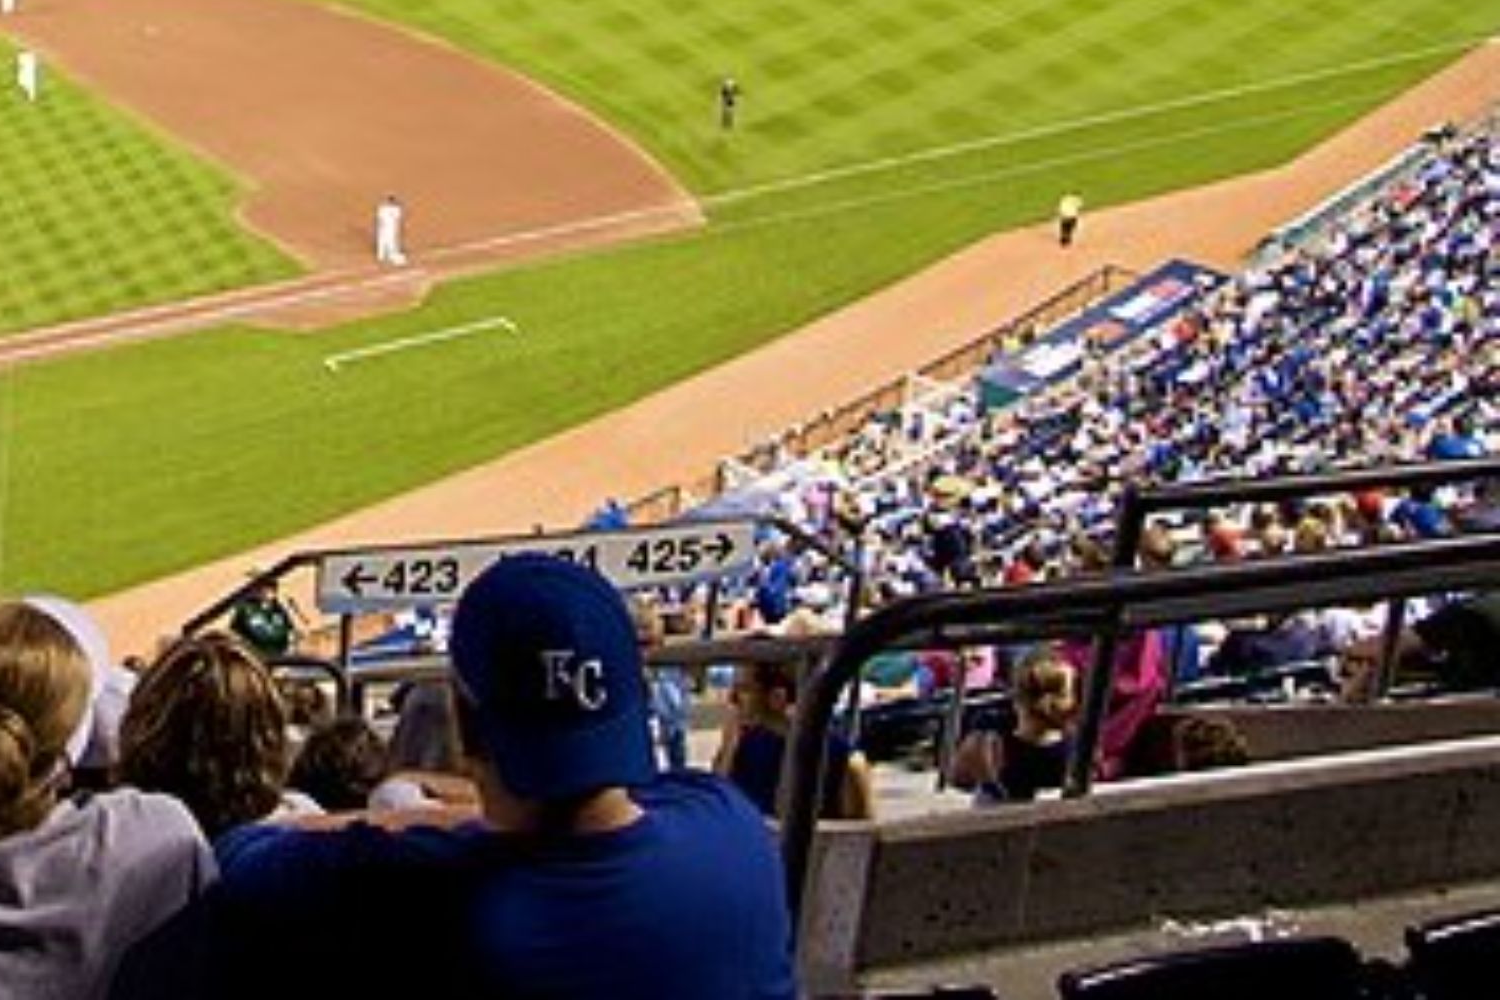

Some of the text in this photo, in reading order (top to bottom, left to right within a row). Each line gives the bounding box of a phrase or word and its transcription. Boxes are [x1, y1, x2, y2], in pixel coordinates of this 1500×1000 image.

[383, 560, 460, 595] 423
[627, 538, 700, 574] 425
[540, 649, 607, 711] KC
